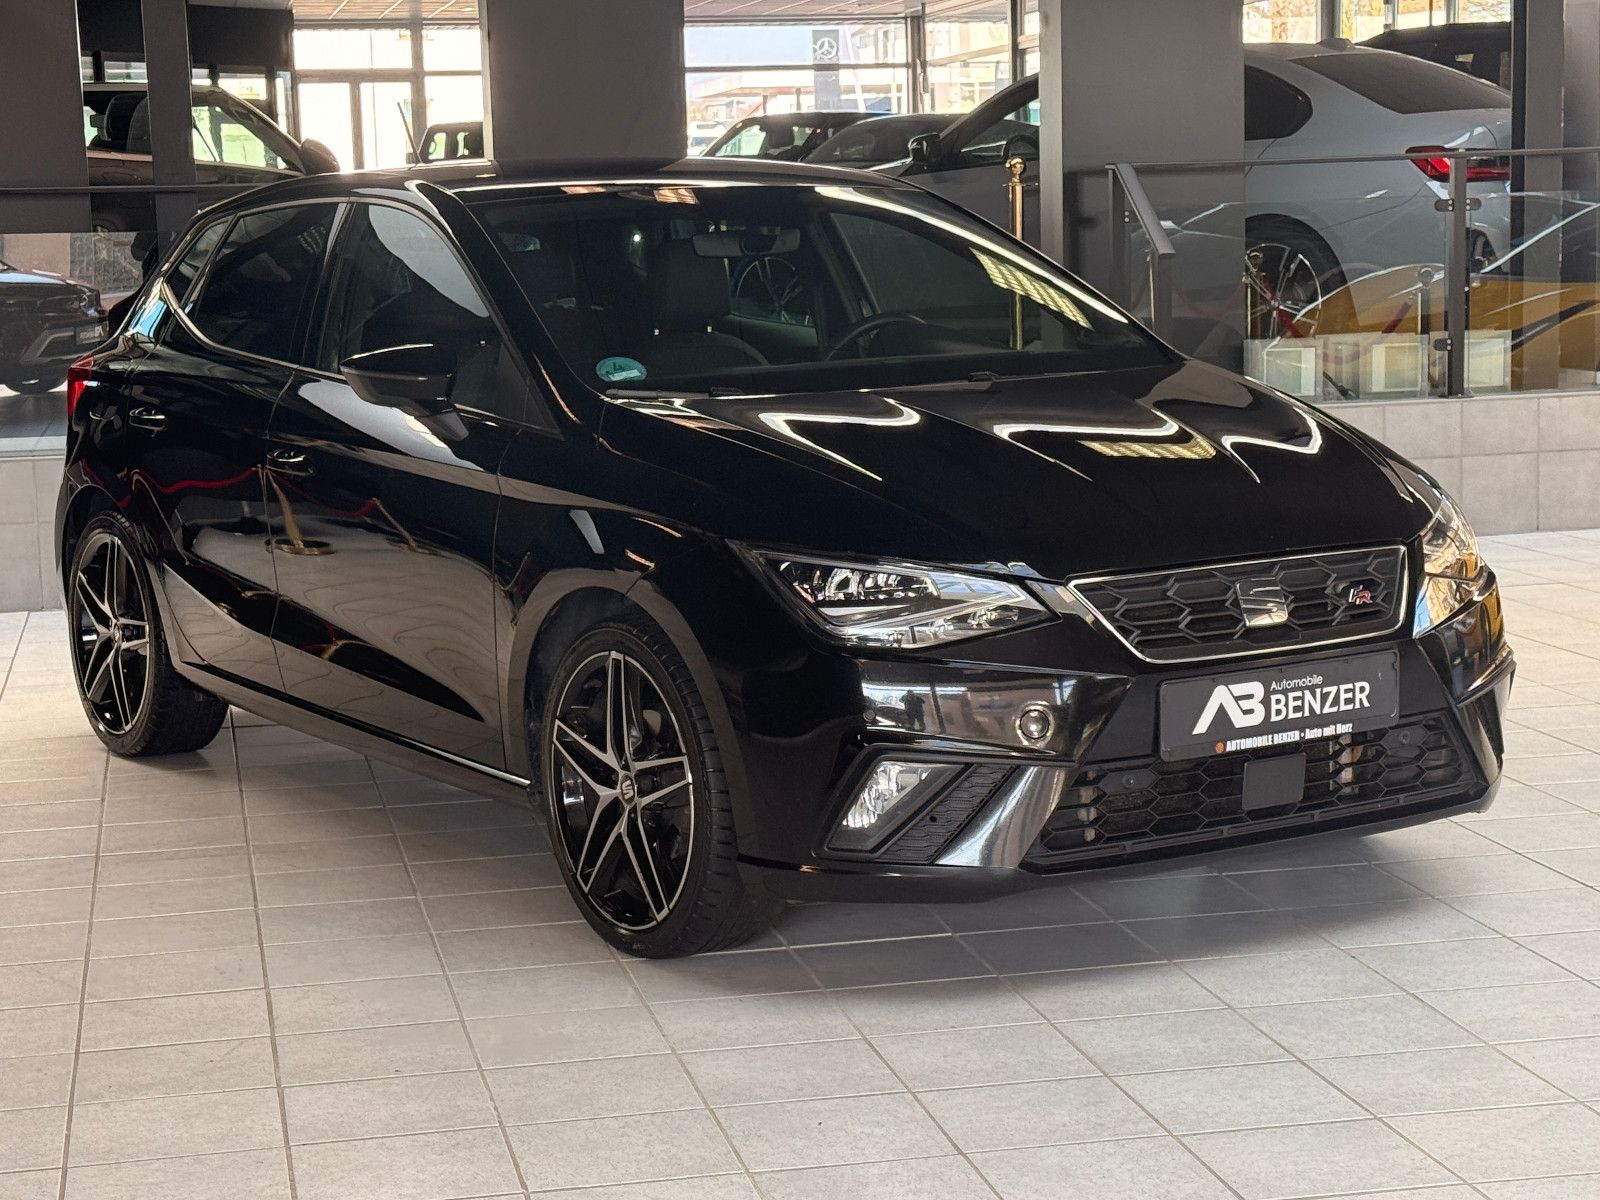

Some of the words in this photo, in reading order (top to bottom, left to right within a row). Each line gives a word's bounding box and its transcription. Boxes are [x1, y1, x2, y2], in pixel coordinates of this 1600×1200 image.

[1270, 674, 1323, 692] Automobile
[1270, 681, 1370, 722] BENZER
[1226, 734, 1273, 752] AUTOMOBILE
[1273, 730, 1300, 745] BENZER
[1305, 727, 1322, 739] Auto
[1323, 724, 1336, 737] mit
[1336, 722, 1353, 734] Herz
